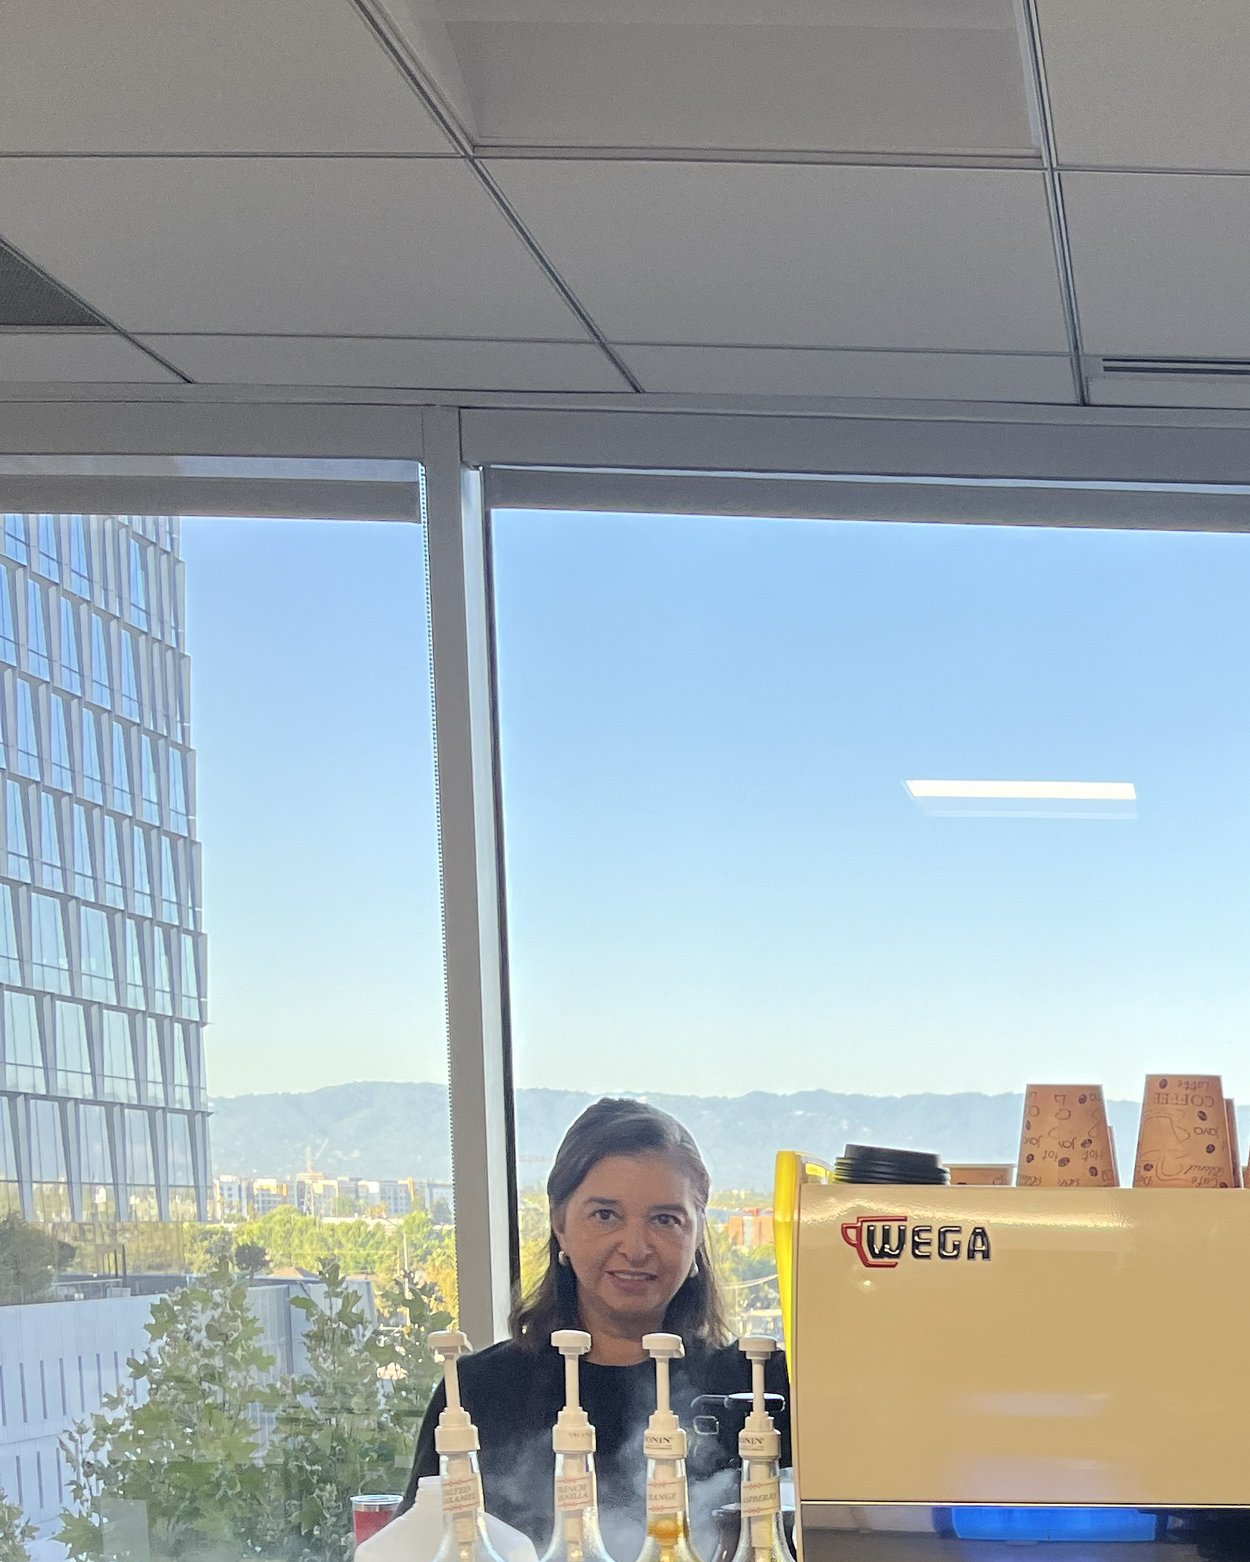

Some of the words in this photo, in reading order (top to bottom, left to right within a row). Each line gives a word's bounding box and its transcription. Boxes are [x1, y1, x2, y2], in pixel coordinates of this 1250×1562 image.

[1153, 1093, 1214, 1107] COFFEE
[866, 1223, 992, 1261] WEGA
[646, 1436, 671, 1444] ONIN
